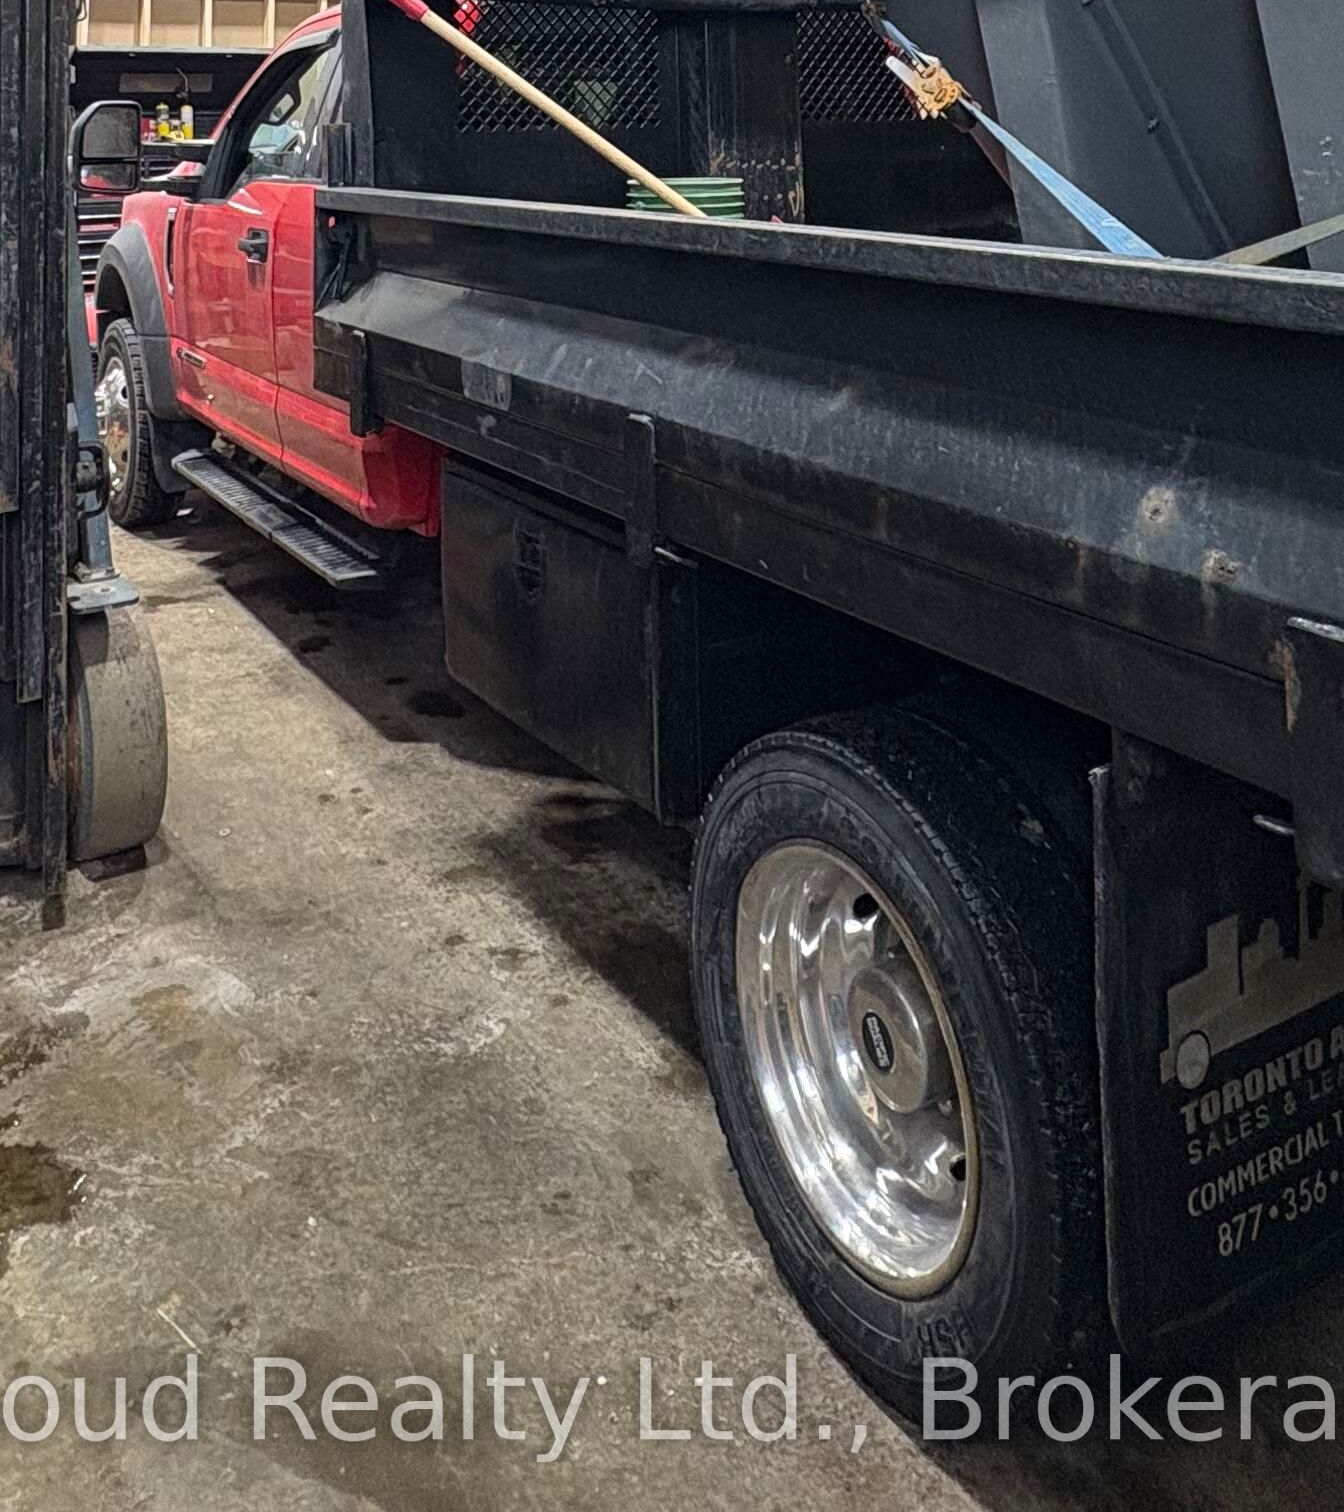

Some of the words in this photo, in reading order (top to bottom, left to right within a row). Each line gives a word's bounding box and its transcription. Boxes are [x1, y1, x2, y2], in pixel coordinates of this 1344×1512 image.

[1180, 1038, 1324, 1134] TORONTO
[1187, 1104, 1270, 1165] SALES
[1284, 1090, 1297, 1116] &
[1188, 1121, 1330, 1217] COMMERCIAL
